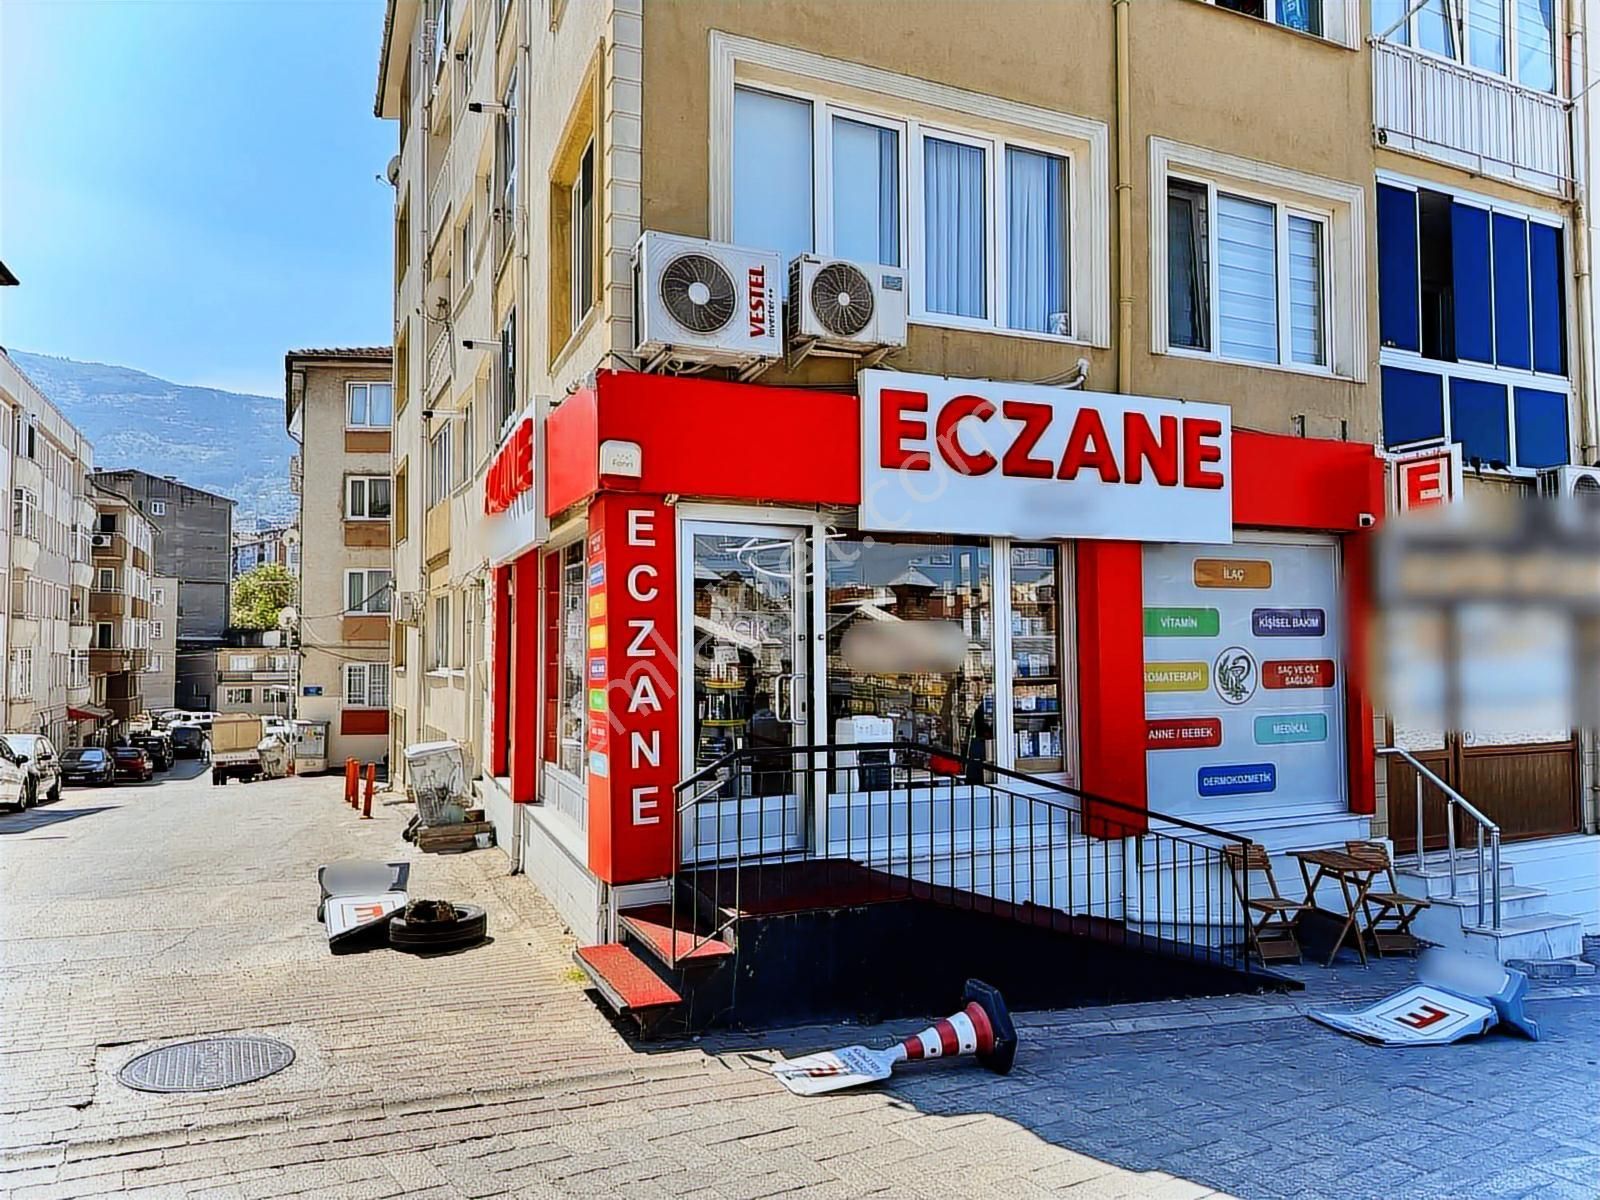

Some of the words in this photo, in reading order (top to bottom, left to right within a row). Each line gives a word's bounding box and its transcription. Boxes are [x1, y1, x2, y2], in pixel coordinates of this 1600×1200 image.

[748, 265, 765, 338] VESTEL
[880, 388, 1222, 489] ECZANE
[1223, 566, 1244, 582] İLAÇ
[1160, 615, 1198, 629] VİTAMİN
[1259, 614, 1291, 630] KİŞİSEL
[1292, 616, 1320, 628] BAKIM
[626, 508, 662, 827] ECZANE
[1277, 664, 1293, 676] SAÇ
[1294, 664, 1304, 674] VE
[1148, 729, 1174, 740] ANNE
[1182, 727, 1214, 739] BEBEK
[1272, 721, 1310, 735] MEDİKAL
